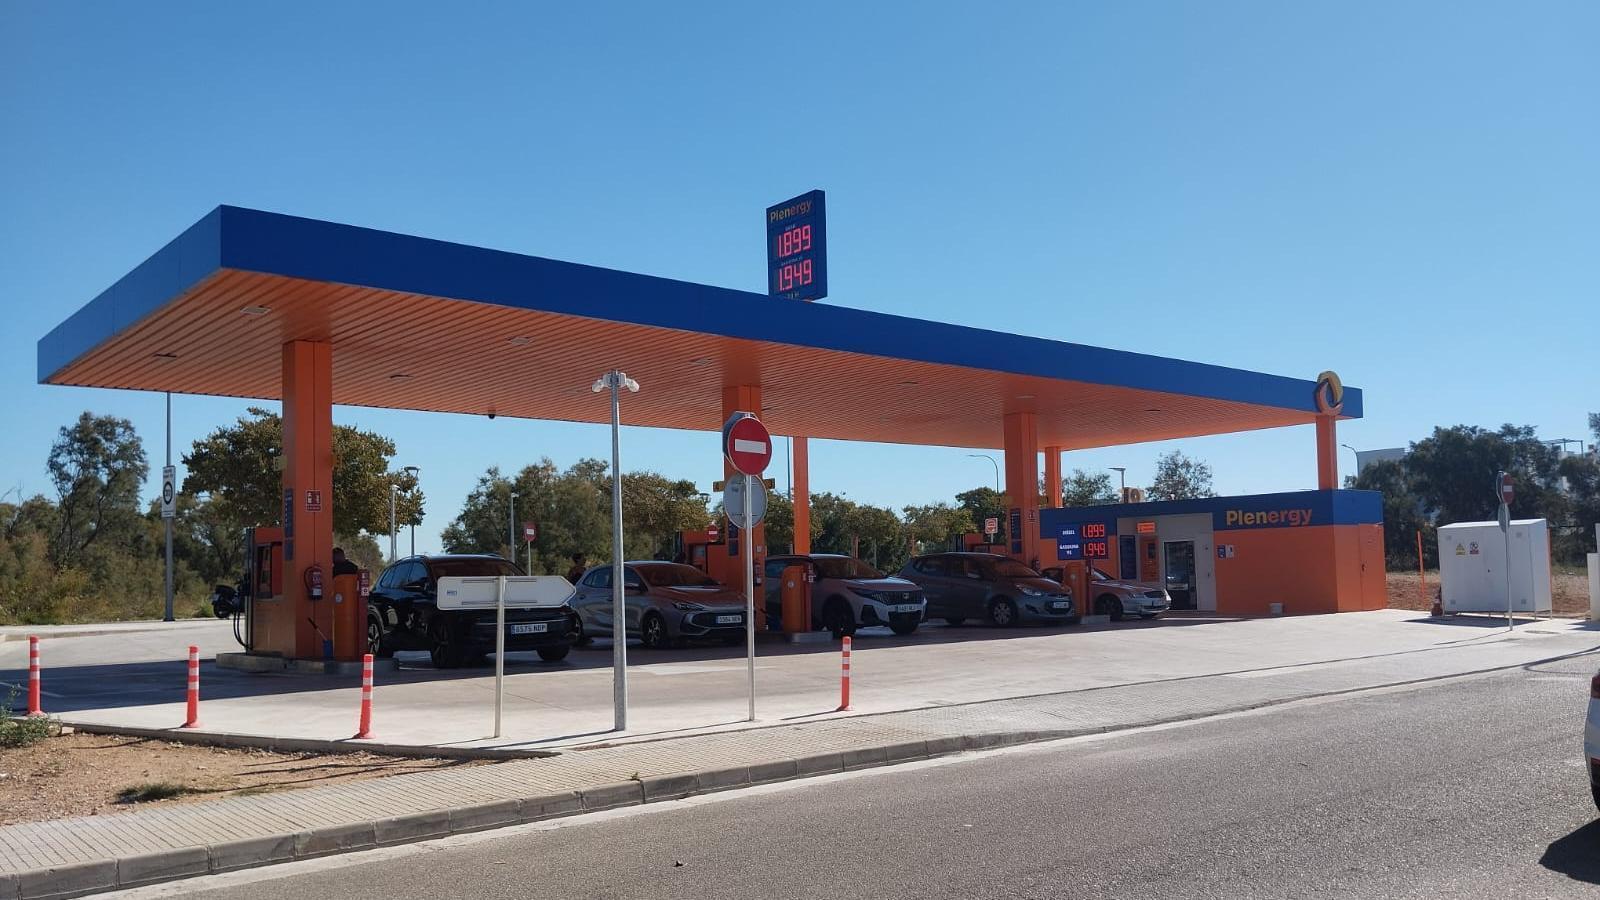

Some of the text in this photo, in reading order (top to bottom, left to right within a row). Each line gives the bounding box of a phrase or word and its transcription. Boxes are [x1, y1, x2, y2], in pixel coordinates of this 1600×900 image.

[770, 200, 812, 223] Plenergy
[779, 259, 812, 291] 1.949
[1226, 508, 1313, 526] Plenergy
